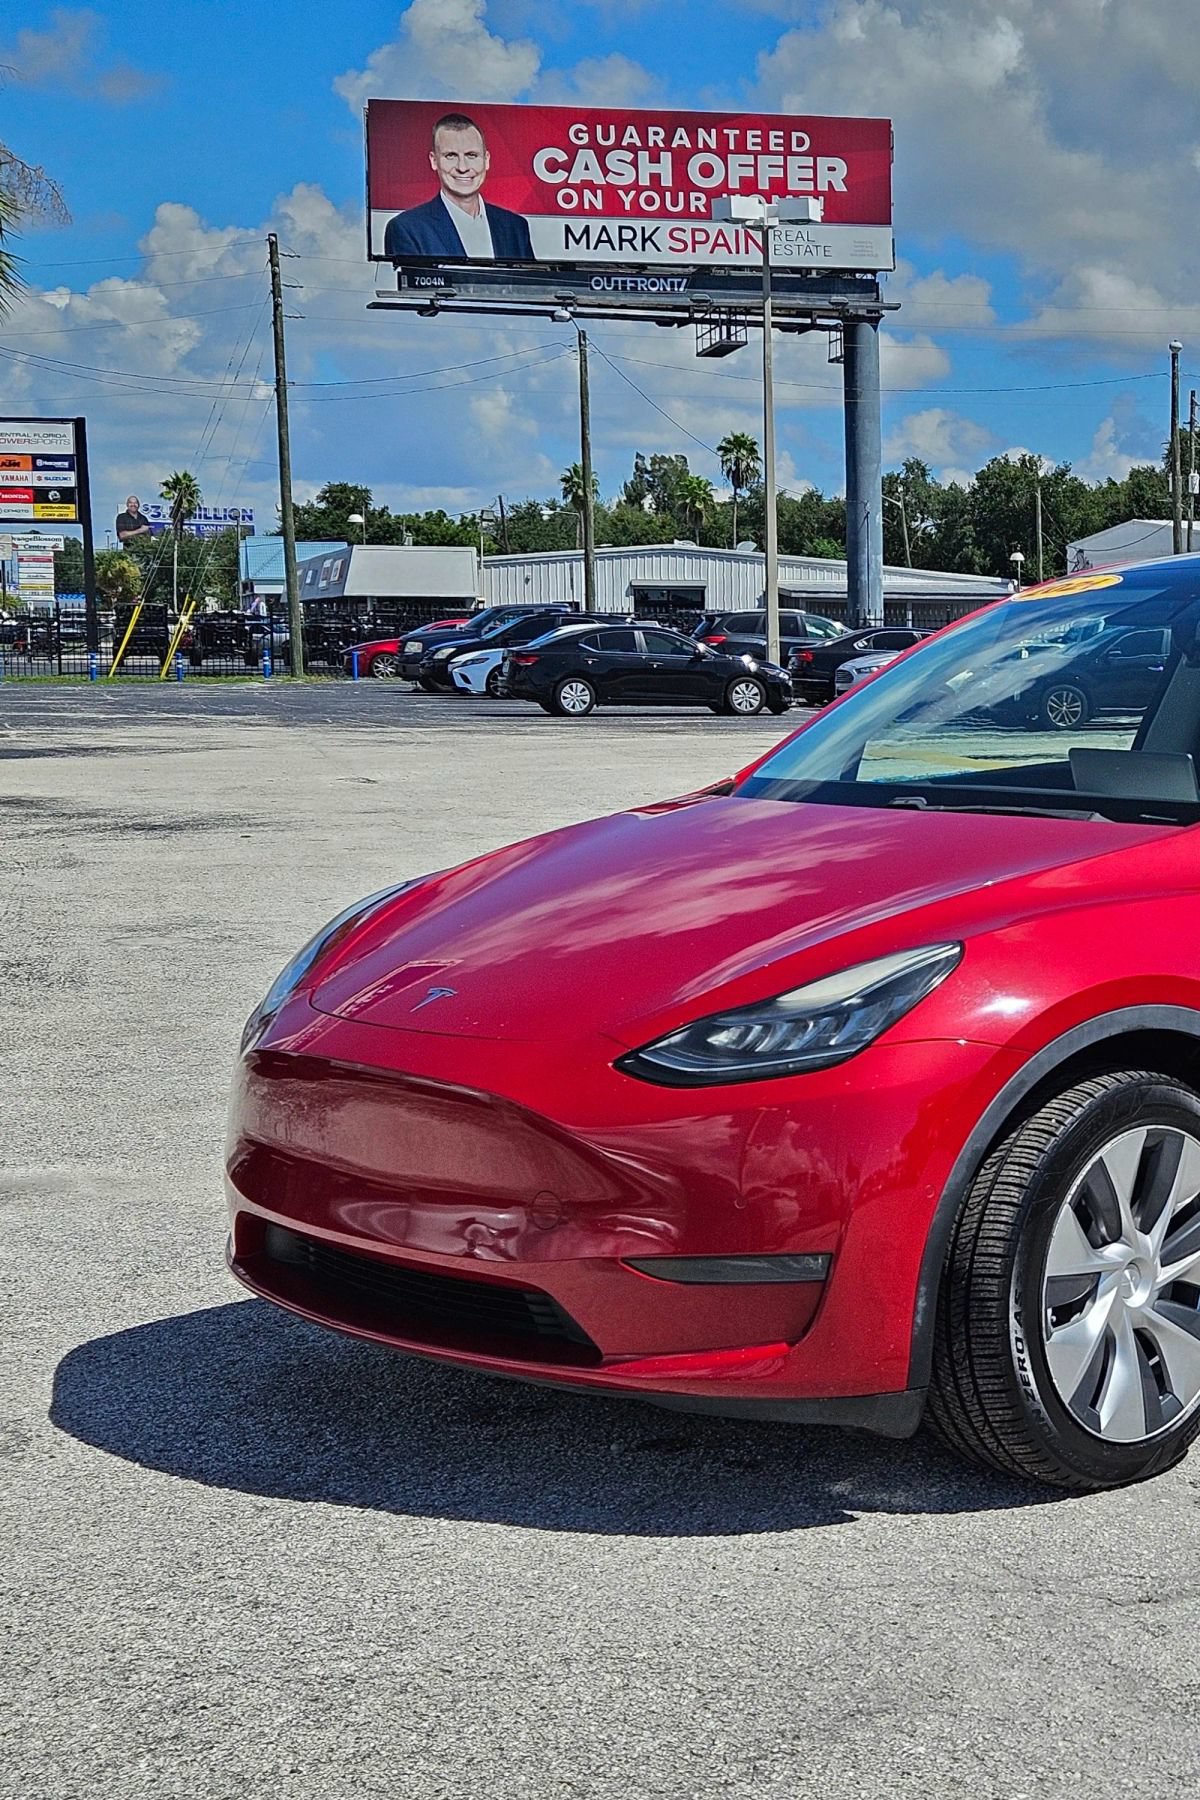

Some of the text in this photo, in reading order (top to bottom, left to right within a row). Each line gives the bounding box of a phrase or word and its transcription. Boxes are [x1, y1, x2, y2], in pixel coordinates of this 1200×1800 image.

[568, 122, 811, 152] GUARANTEED
[532, 147, 848, 192] CASH OFFER
[556, 188, 604, 210] ON
[617, 190, 707, 213] YOUR
[564, 223, 766, 255] MARK SPAIN
[773, 229, 816, 243] REAL
[773, 244, 833, 257] ESTATE
[414, 276, 445, 286] 7004N
[0, 437, 71, 445] OWERSPORTS
[192, 506, 253, 521] ILLION
[1014, 1337, 1038, 1404] ZERO
